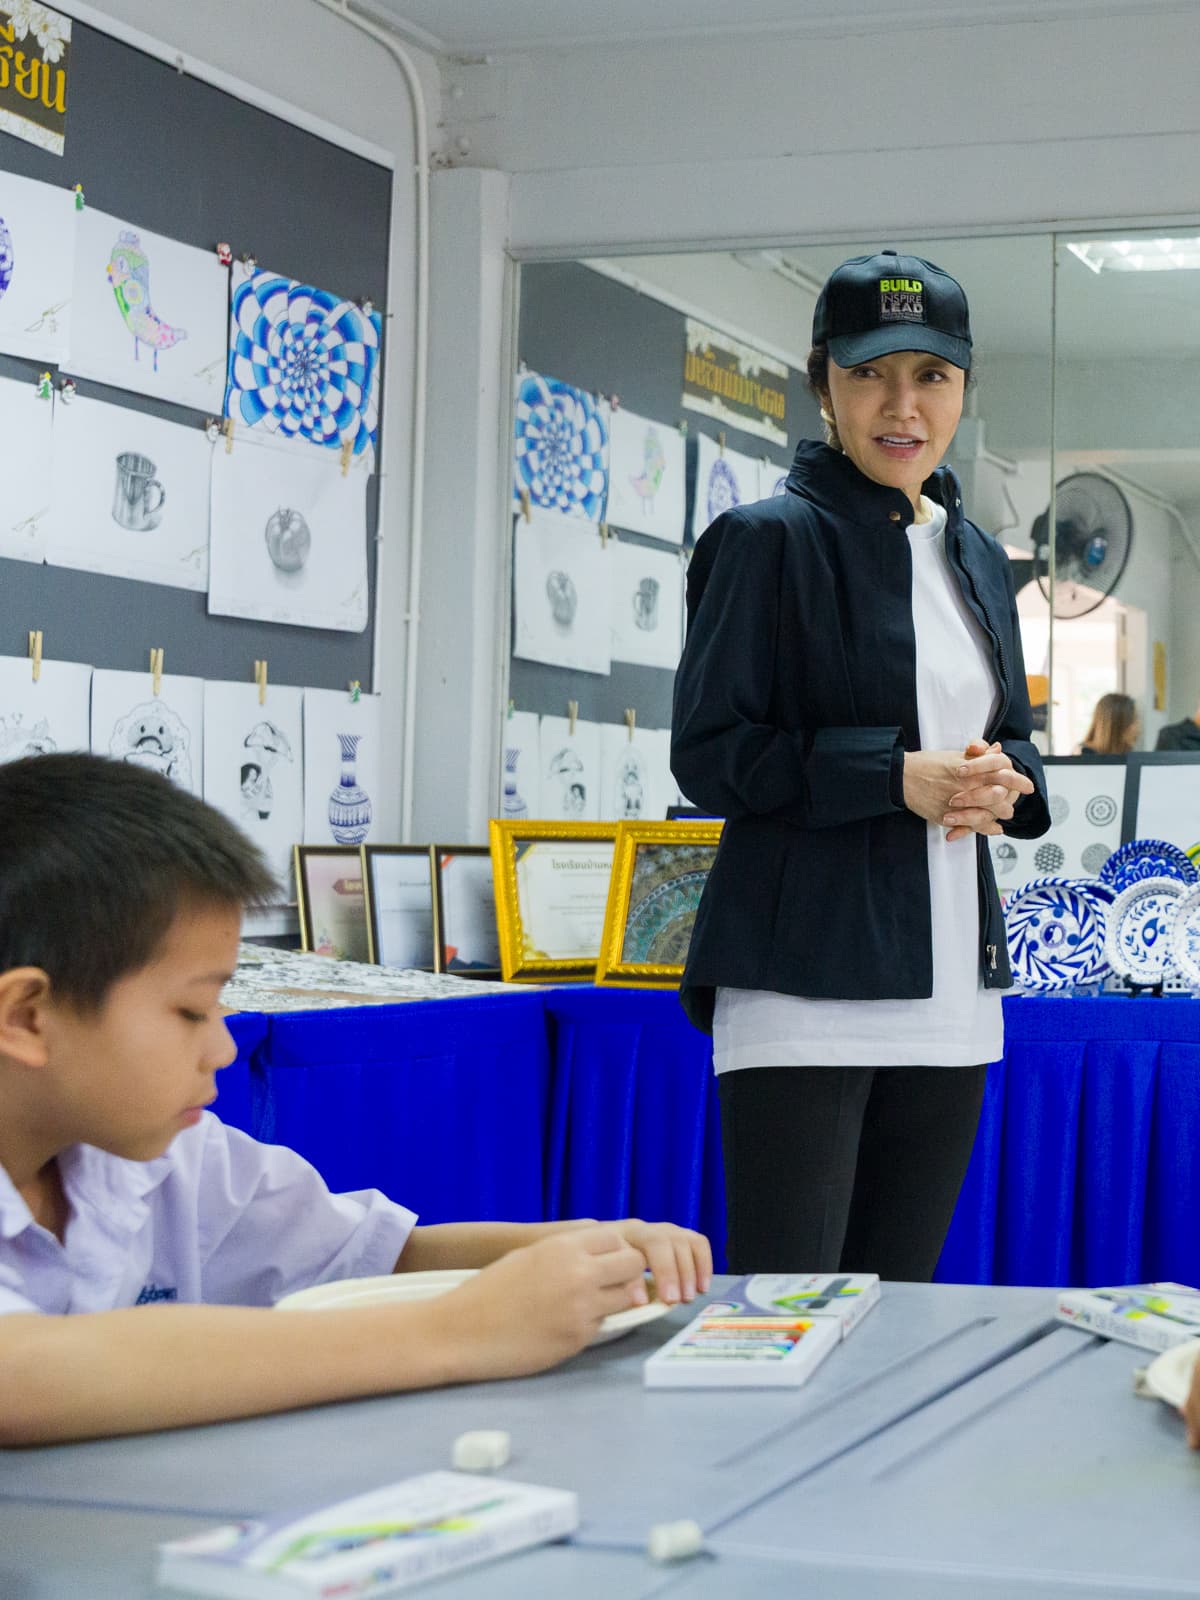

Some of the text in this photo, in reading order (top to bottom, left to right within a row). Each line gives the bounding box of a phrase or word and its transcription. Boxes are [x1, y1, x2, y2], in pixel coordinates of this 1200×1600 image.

[880, 279, 923, 293] BUILD
[881, 294, 922, 304] INSPIRE
[881, 302, 924, 313] LEAD
